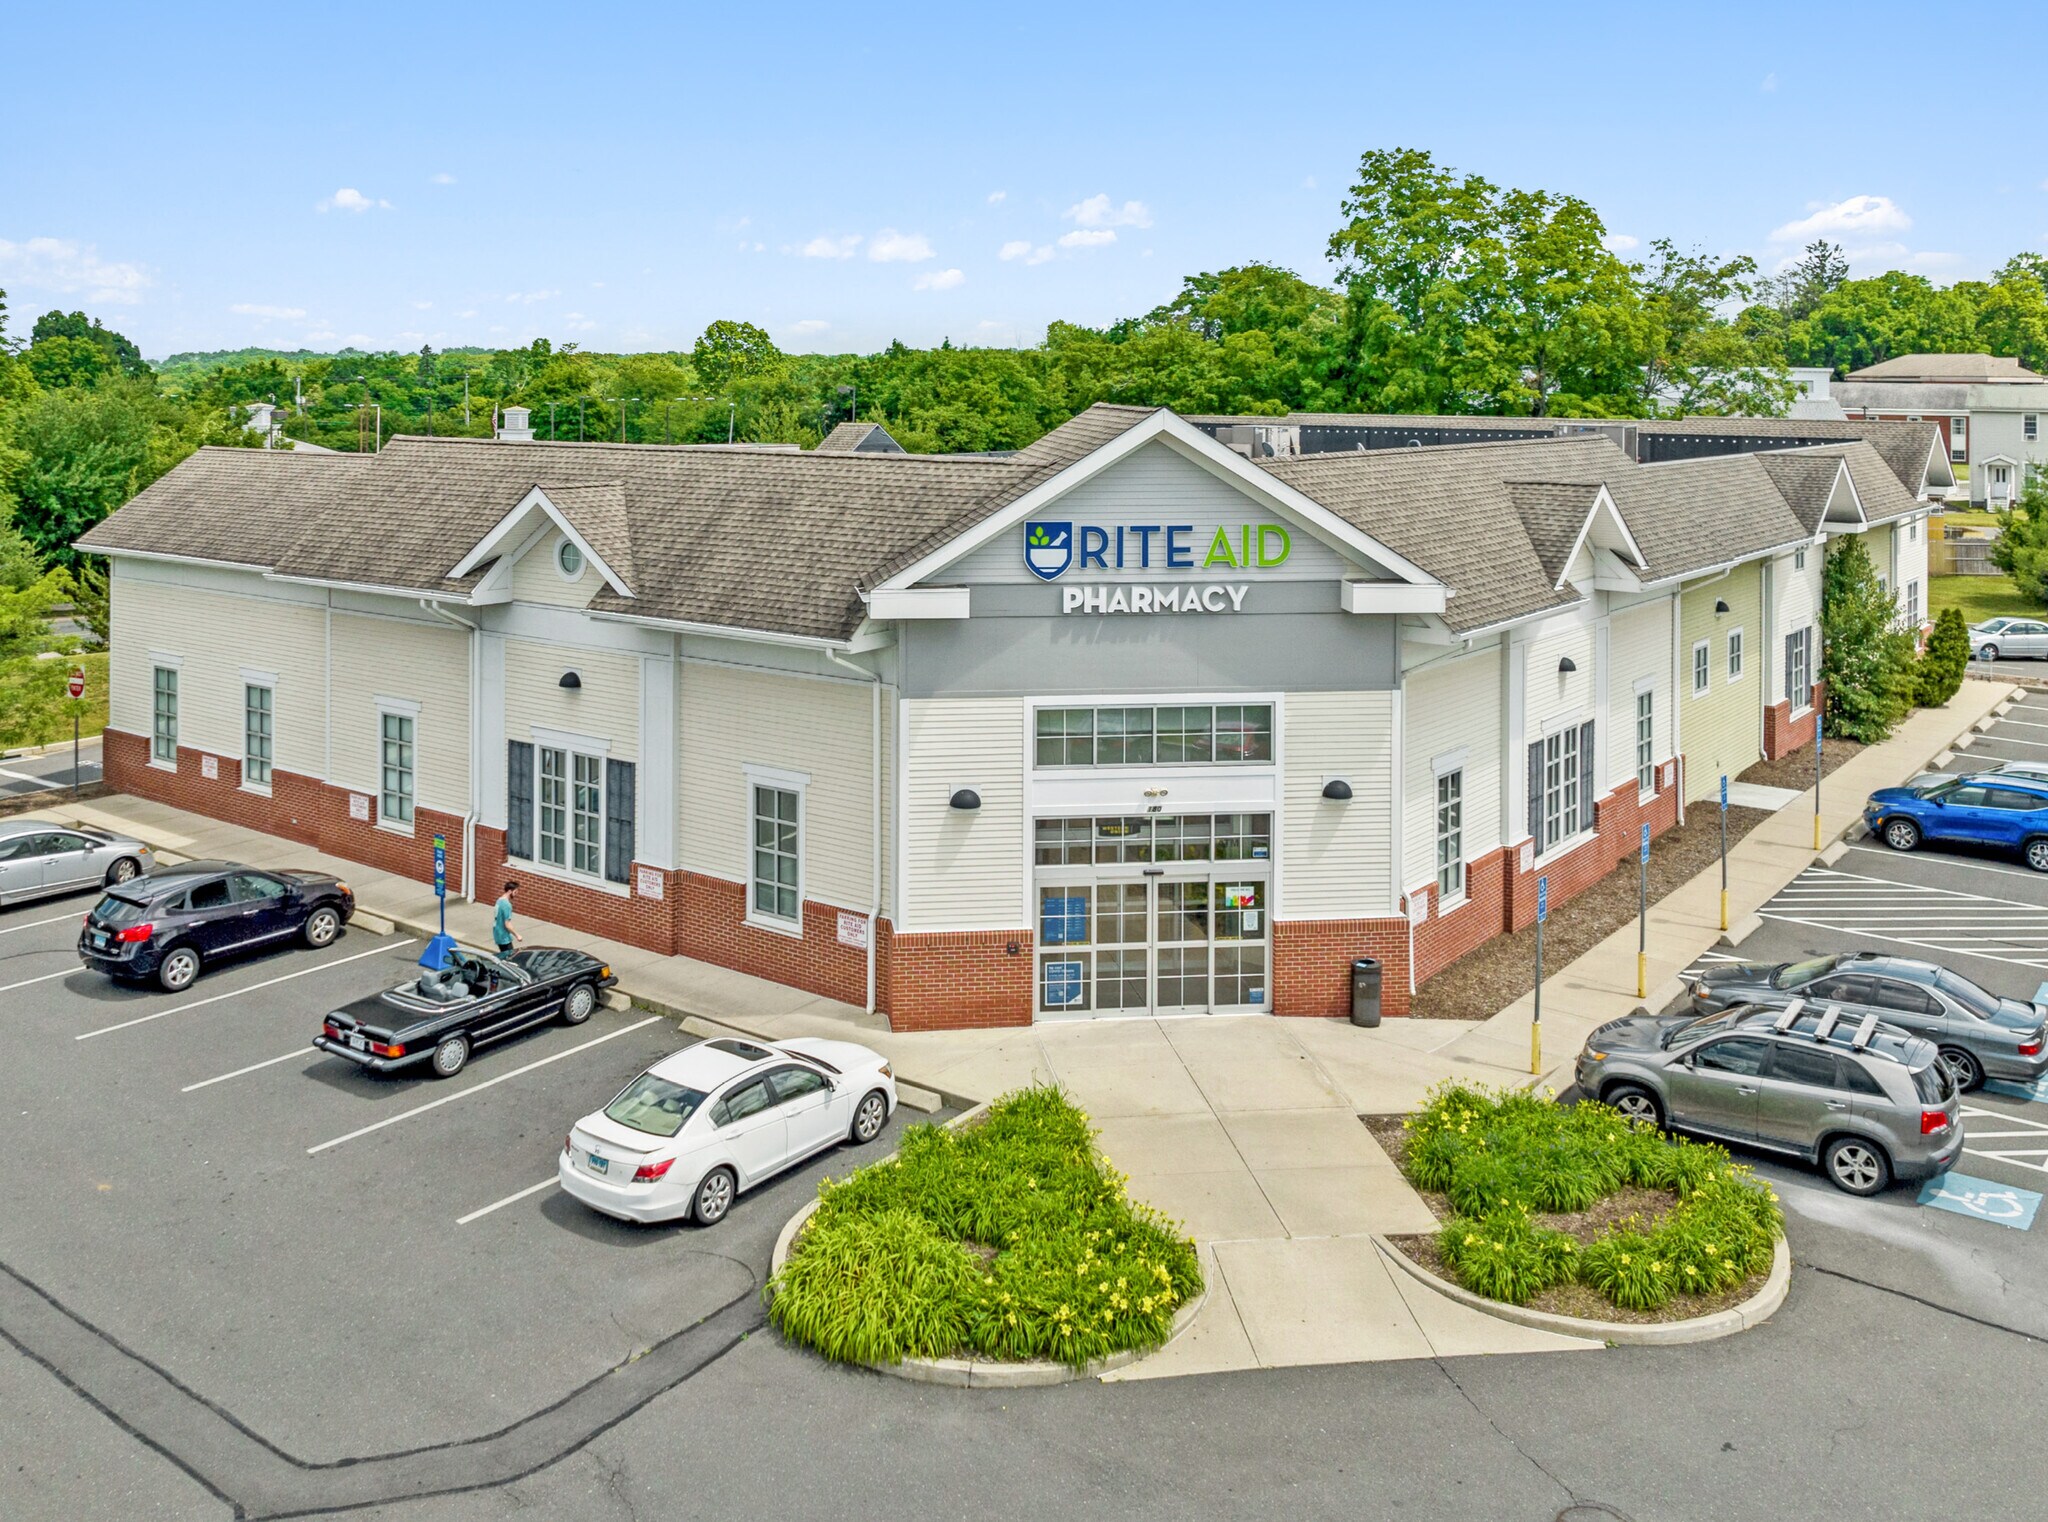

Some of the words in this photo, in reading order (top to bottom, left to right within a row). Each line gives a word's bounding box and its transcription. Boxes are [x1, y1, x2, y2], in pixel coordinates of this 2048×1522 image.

[1079, 525, 1194, 569] RITE
[1202, 524, 1292, 568] AID
[1062, 585, 1249, 614] PHARMACY
[840, 914, 857, 922] PARKING
[840, 925, 865, 935] CUSTOMERS
